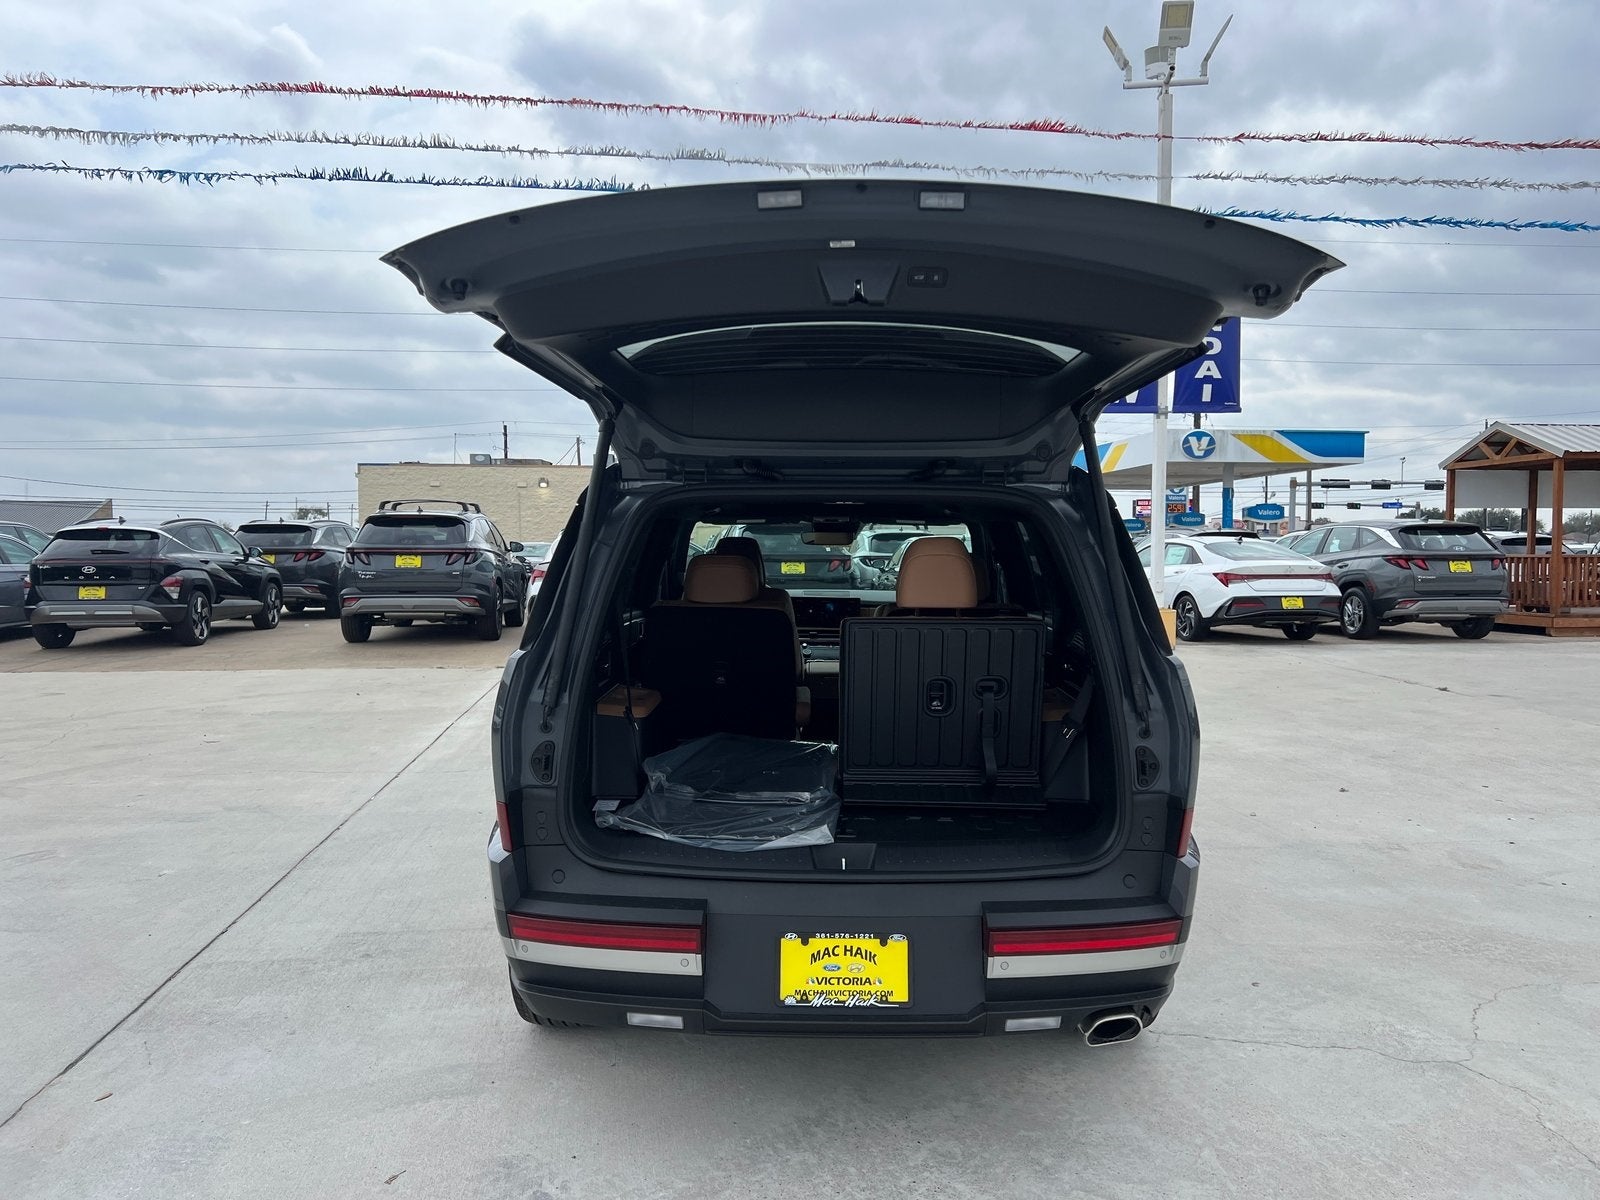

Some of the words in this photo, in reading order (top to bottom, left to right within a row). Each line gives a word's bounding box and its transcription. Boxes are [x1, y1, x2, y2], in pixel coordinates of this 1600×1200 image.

[1194, 325, 1222, 402] DAI
[810, 945, 840, 965] MAC
[844, 945, 878, 966] HAIK
[815, 977, 873, 986] VICTORIA
[810, 994, 840, 1008] Mac
[845, 994, 880, 1008] Haik
